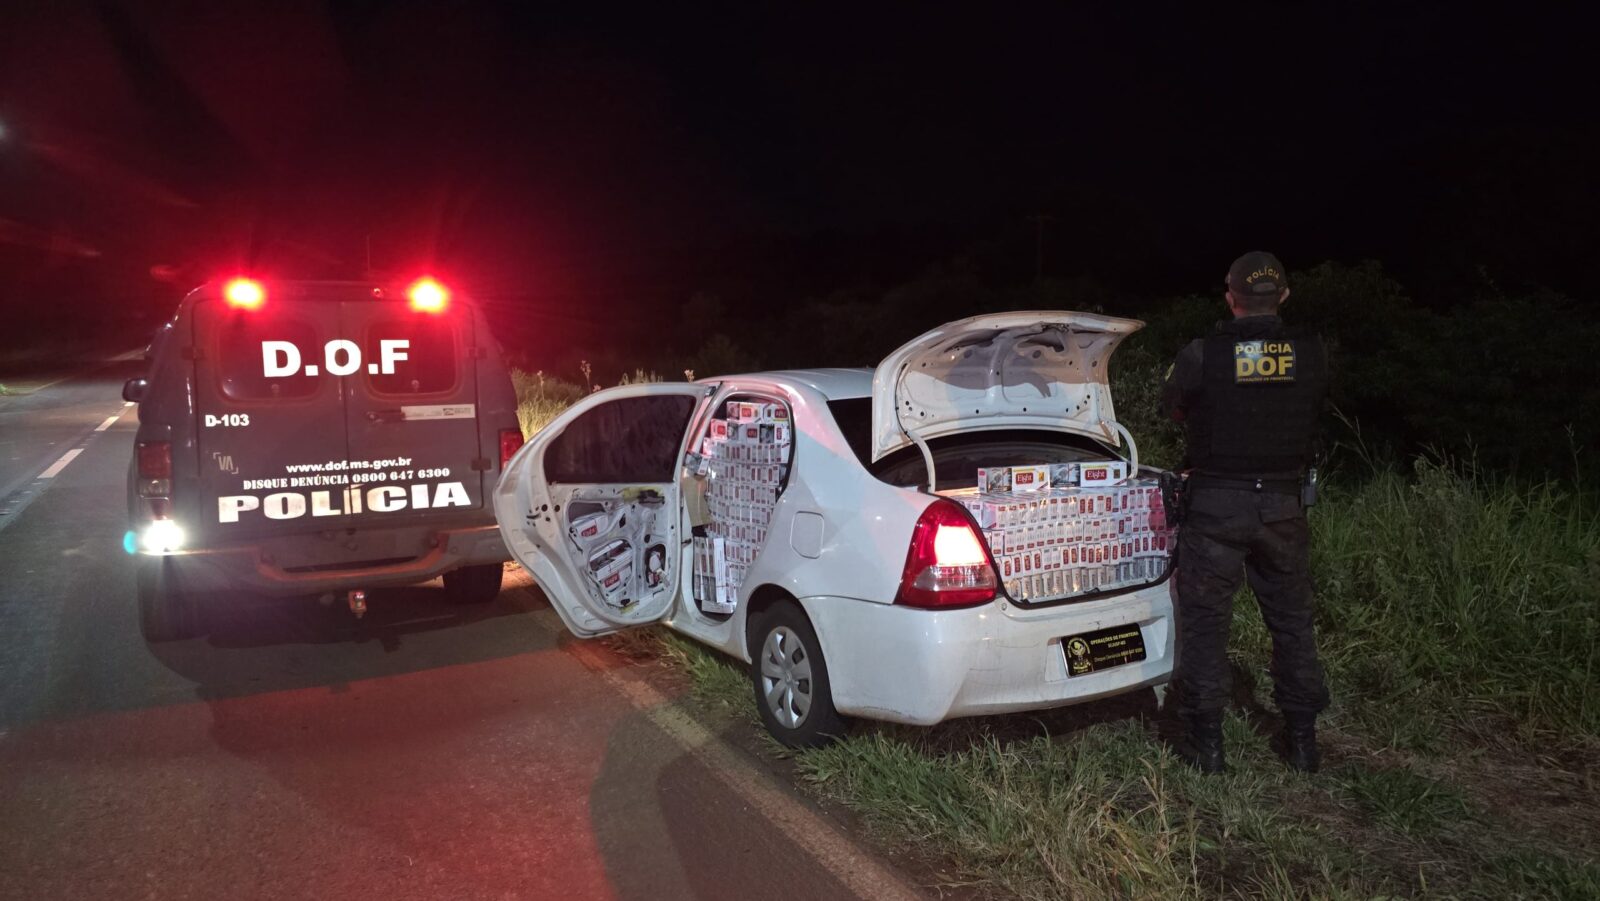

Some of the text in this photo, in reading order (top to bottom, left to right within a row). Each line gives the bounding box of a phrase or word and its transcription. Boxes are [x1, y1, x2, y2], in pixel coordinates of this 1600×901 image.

[1246, 266, 1280, 283] POLÍCIA
[1235, 341, 1292, 354] POLÍCIA
[262, 339, 410, 378] D.O.F
[1237, 356, 1293, 377] DOF
[205, 413, 250, 427] D-103
[286, 457, 412, 473] www.dof.ms.gov.br
[243, 467, 450, 490] DISQUE DENÚNCIA 0800 647 6300
[1087, 470, 1105, 480] Eight
[218, 481, 472, 523] POLÍCIA
